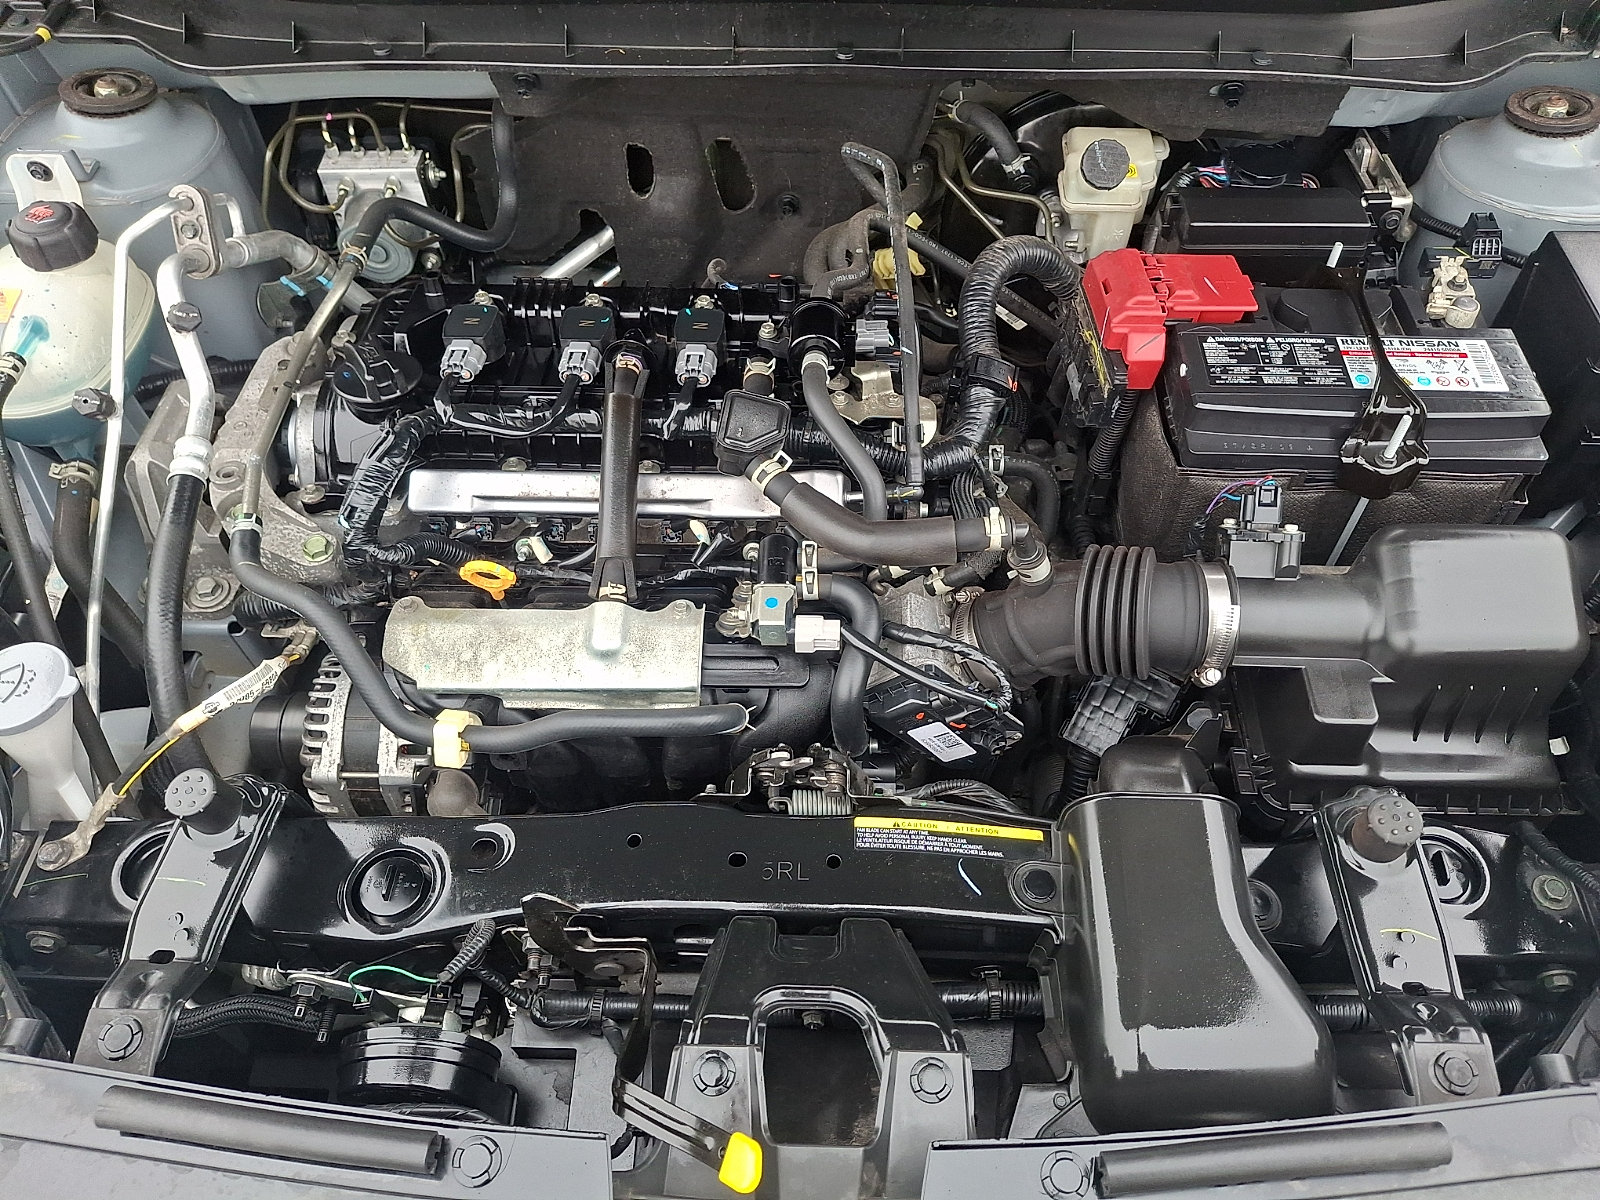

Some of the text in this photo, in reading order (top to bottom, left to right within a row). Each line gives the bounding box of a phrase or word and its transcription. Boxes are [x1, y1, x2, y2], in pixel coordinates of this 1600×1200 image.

[1340, 338, 1459, 348] RENLT NISSAN
[955, 826, 999, 834] ATTENTION
